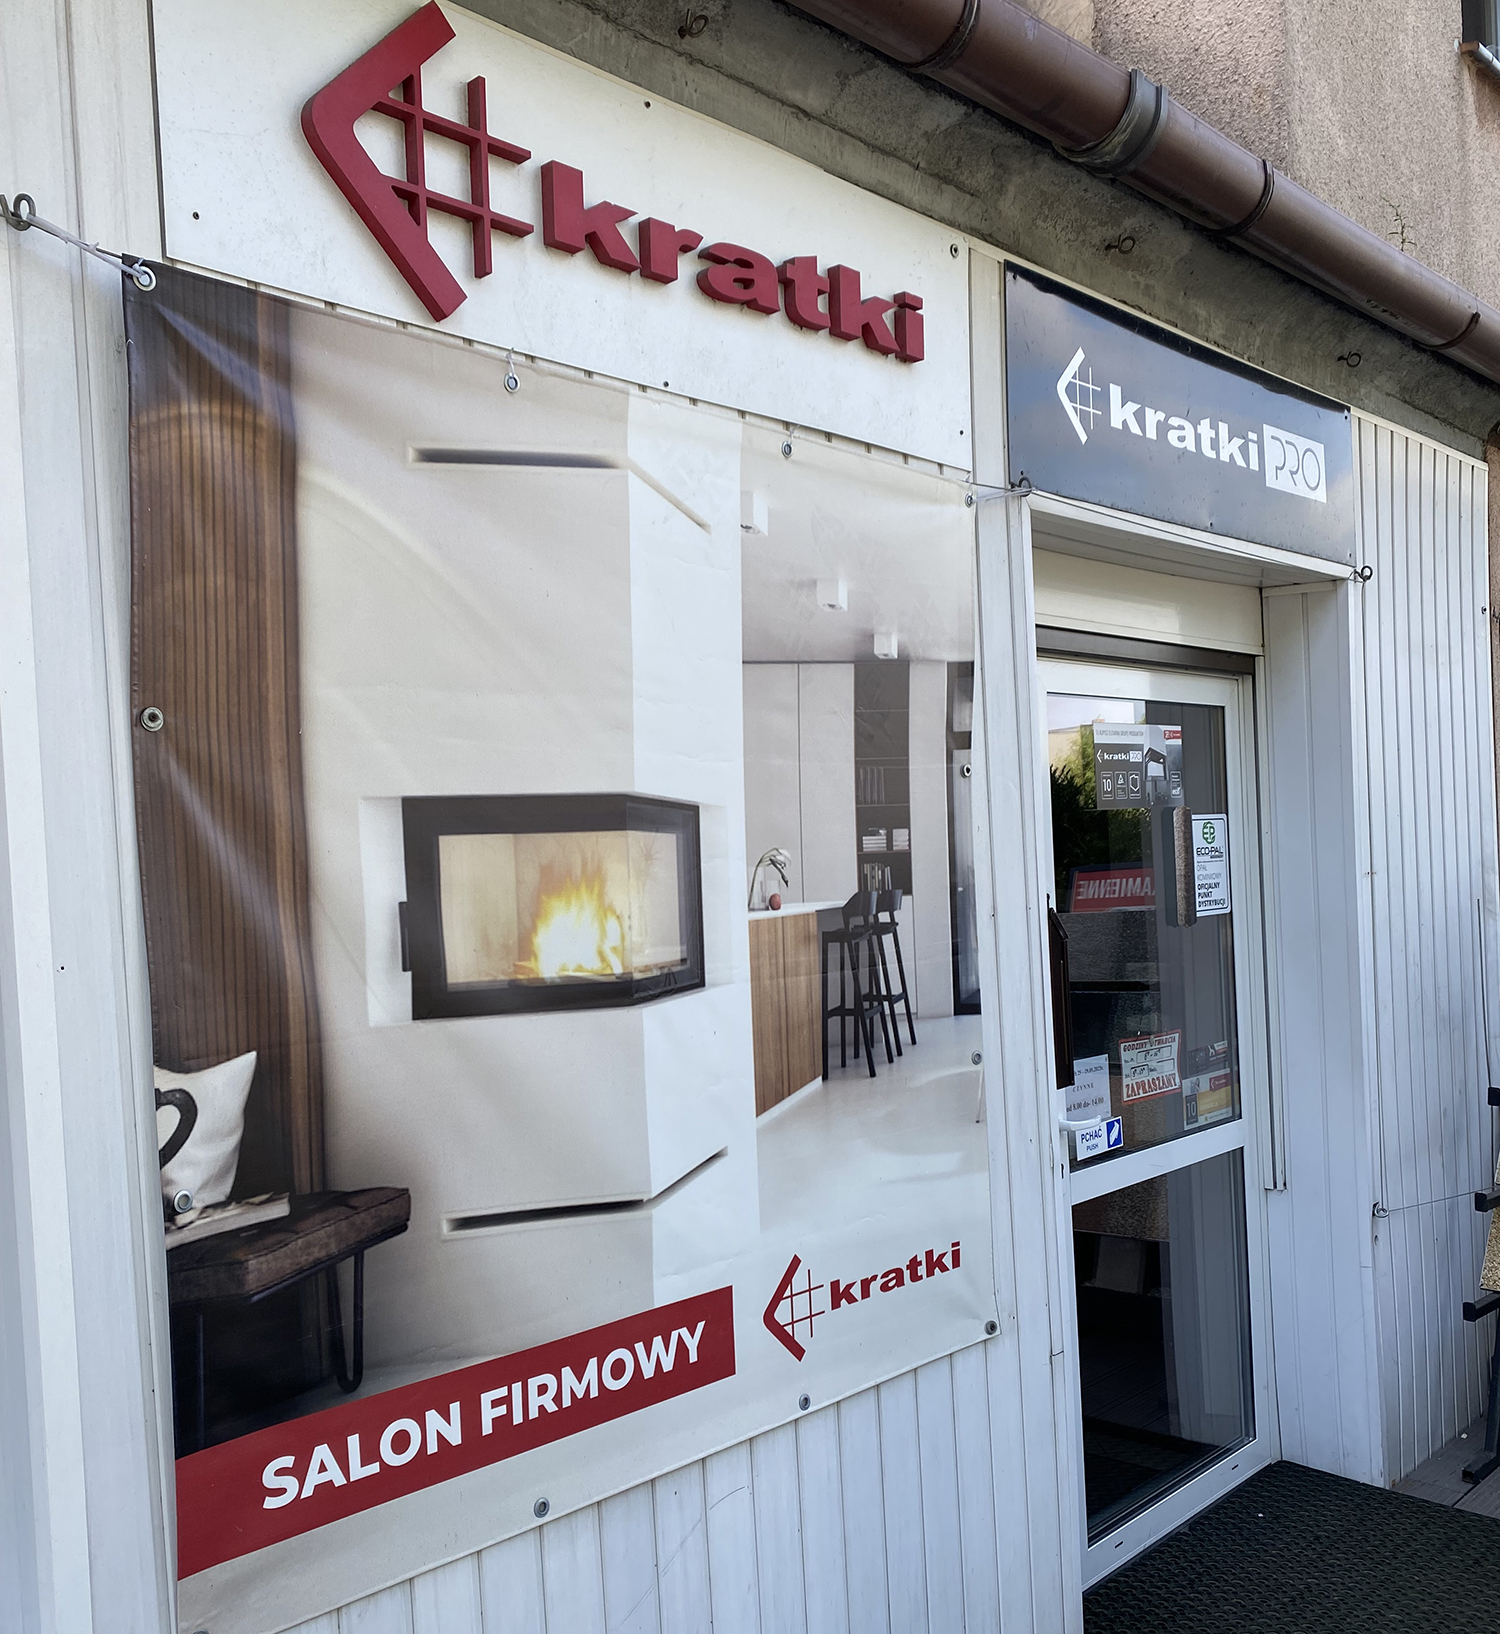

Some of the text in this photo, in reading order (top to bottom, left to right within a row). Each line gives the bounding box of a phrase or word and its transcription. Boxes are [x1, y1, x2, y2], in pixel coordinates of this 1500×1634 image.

[540, 159, 925, 363] kratki
[1109, 382, 1322, 493] kratki PRO
[1104, 752, 1129, 760] kratki
[1102, 779, 1112, 792] 10
[1198, 891, 1212, 899] PUNKT
[1072, 1082, 1094, 1092] CZYNNE
[1125, 1073, 1177, 1098] ZAPRASZAMY
[1187, 1101, 1197, 1117] 10
[1081, 1126, 1102, 1144] PCHAĆ
[1086, 1142, 1099, 1152] PUSH
[830, 1241, 961, 1311] kratki
[260, 1321, 706, 1509] SALON FIRMOWY
